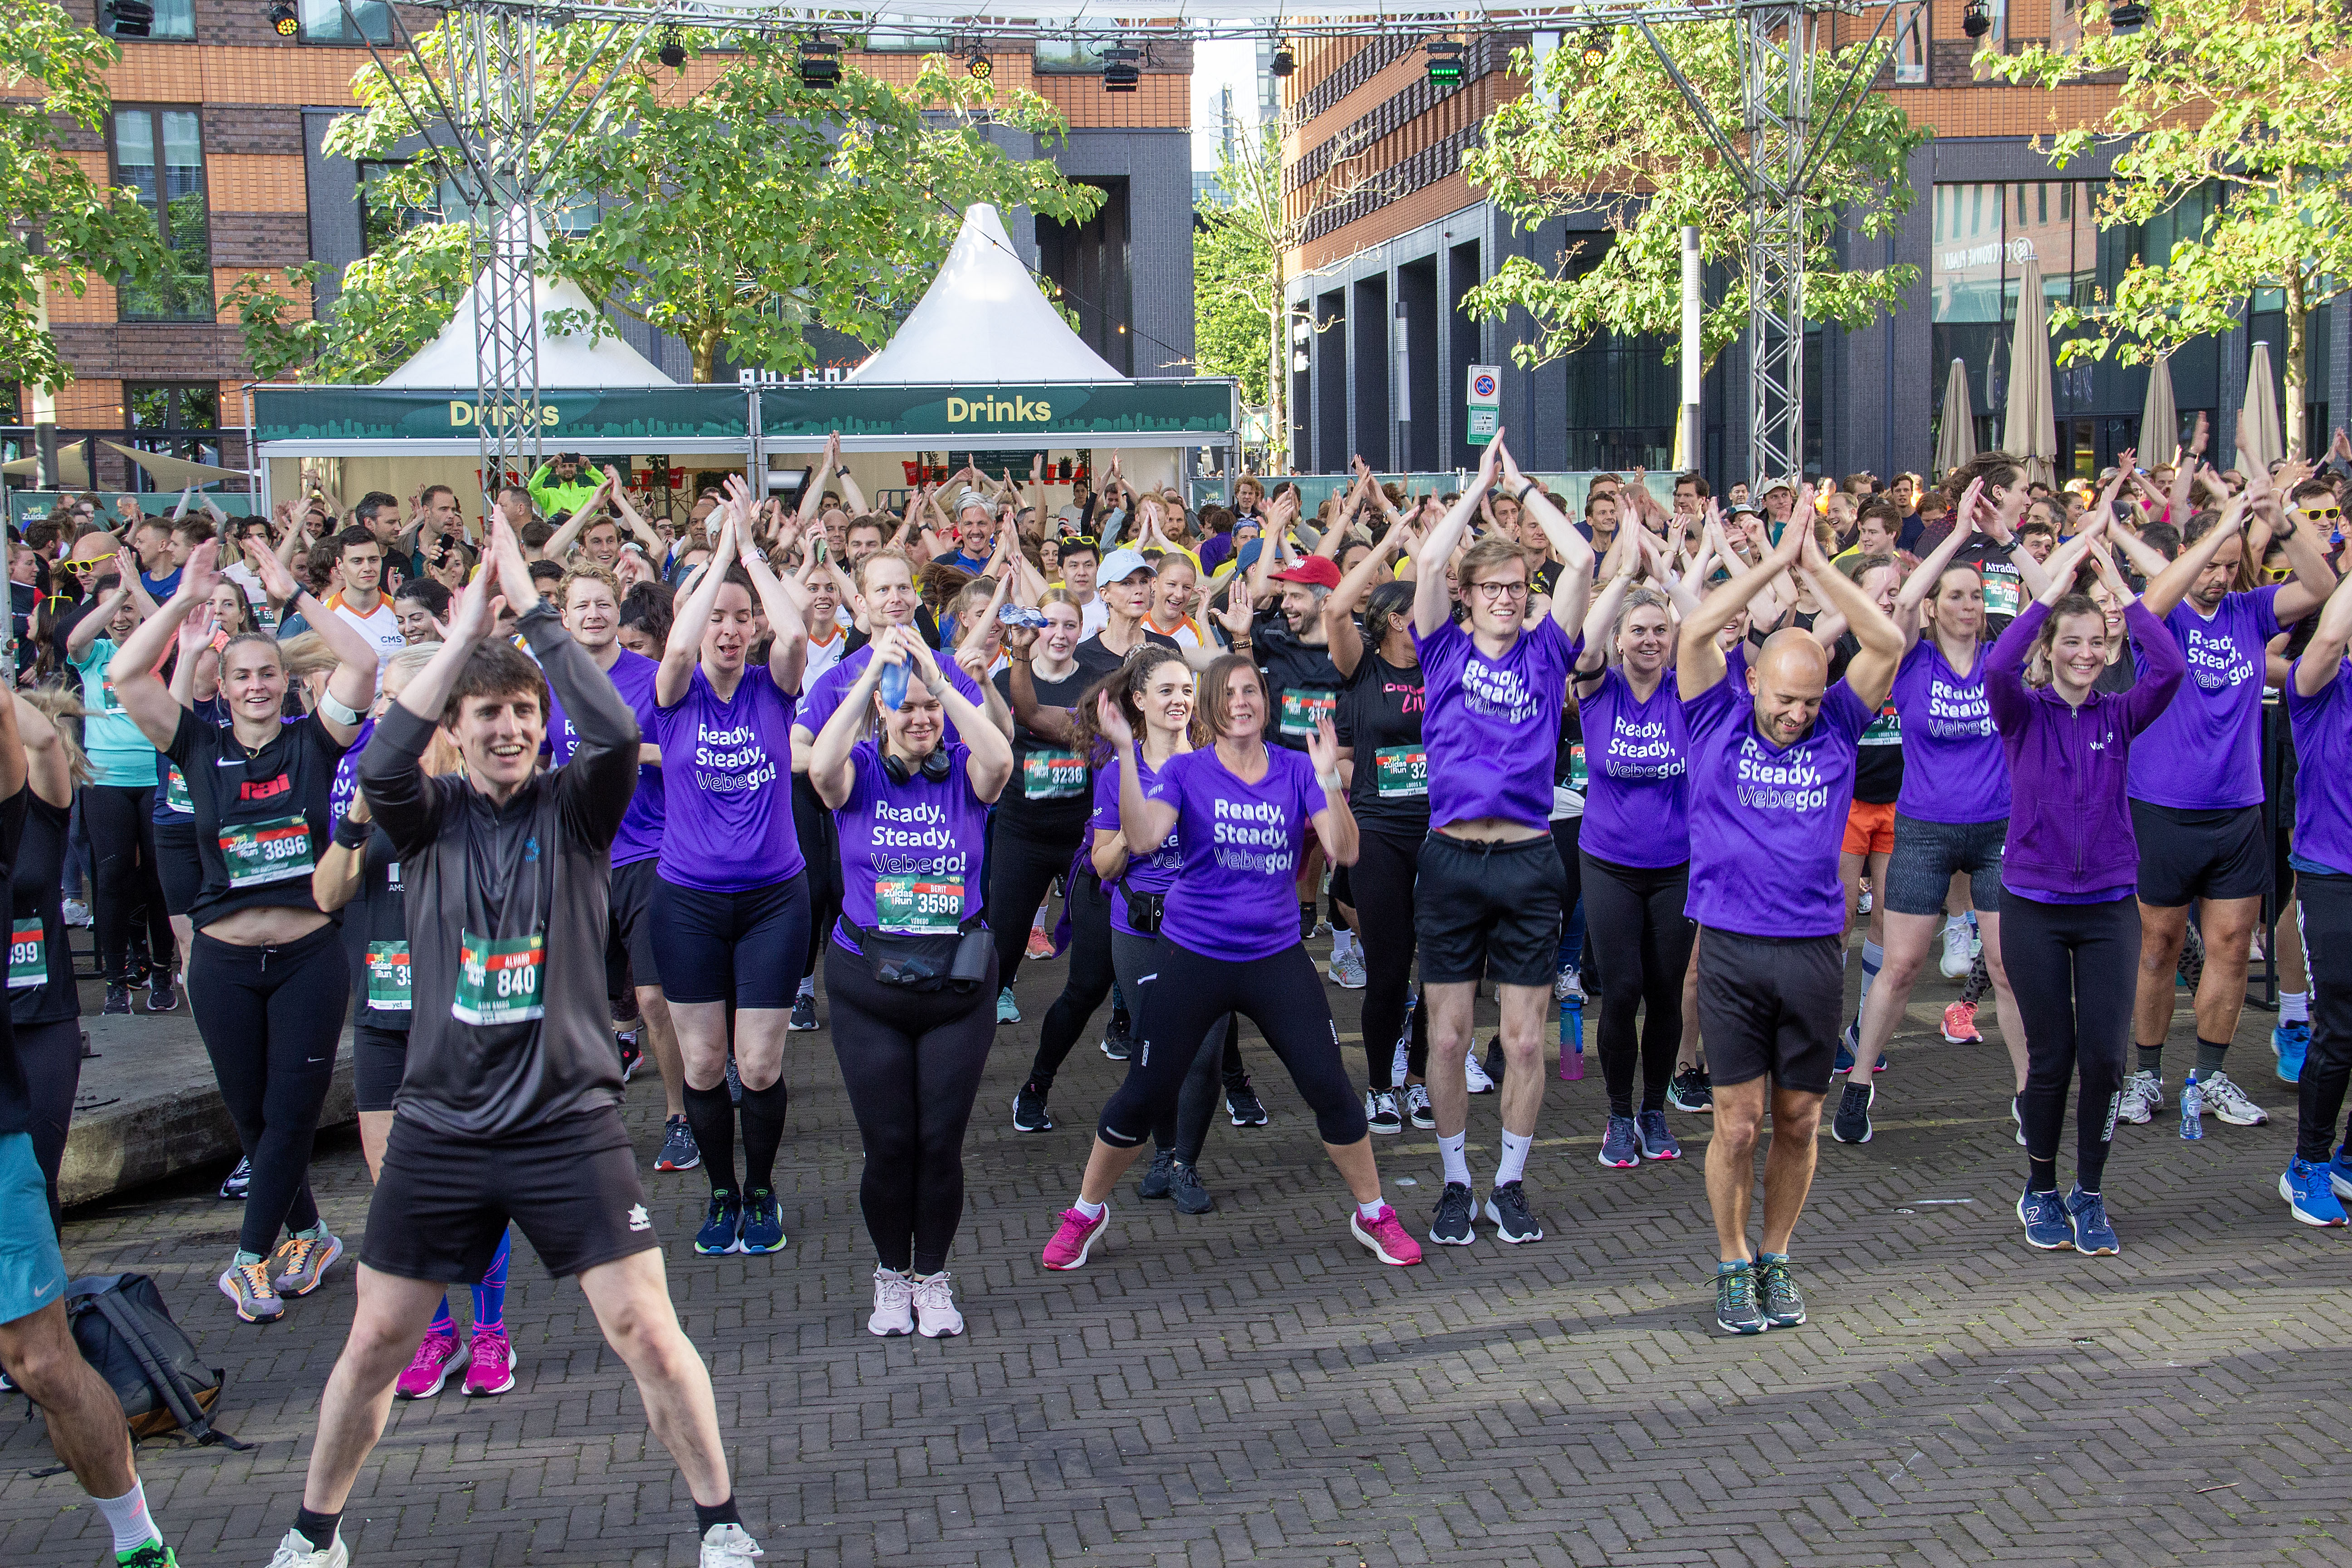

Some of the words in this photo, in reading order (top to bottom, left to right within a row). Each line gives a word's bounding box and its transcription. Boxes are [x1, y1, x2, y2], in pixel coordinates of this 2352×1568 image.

[450, 399, 559, 426] Drinks
[947, 395, 1051, 422] Drinks
[28, 506, 43, 514] yet
[698, 724, 755, 745] Ready,
[1615, 716, 1666, 739] Ready,
[696, 746, 766, 768] Steady,
[1387, 755, 1400, 763] yet
[1608, 738, 1675, 759] Steady,
[696, 762, 777, 792] Vebego!
[1383, 761, 1407, 769] Zuidas
[1606, 757, 1686, 779] Vebego!
[1738, 759, 1821, 787] Steady,
[1737, 784, 1828, 812] Vebego!
[875, 800, 946, 825] Ready,
[1214, 798, 1285, 826] Ready,
[872, 826, 956, 850] Steady,
[1214, 821, 1288, 850] Steady,
[263, 835, 307, 861] 3896
[871, 851, 966, 876] Vebego!
[1214, 846, 1292, 875] Vebego!
[883, 888, 913, 898] Zuidas
[890, 881, 905, 892] yet
[930, 884, 947, 894] BERIT
[917, 893, 959, 915] 3598
[10, 941, 38, 965] 99
[505, 952, 530, 968] ALVARO
[497, 965, 536, 997] 840
